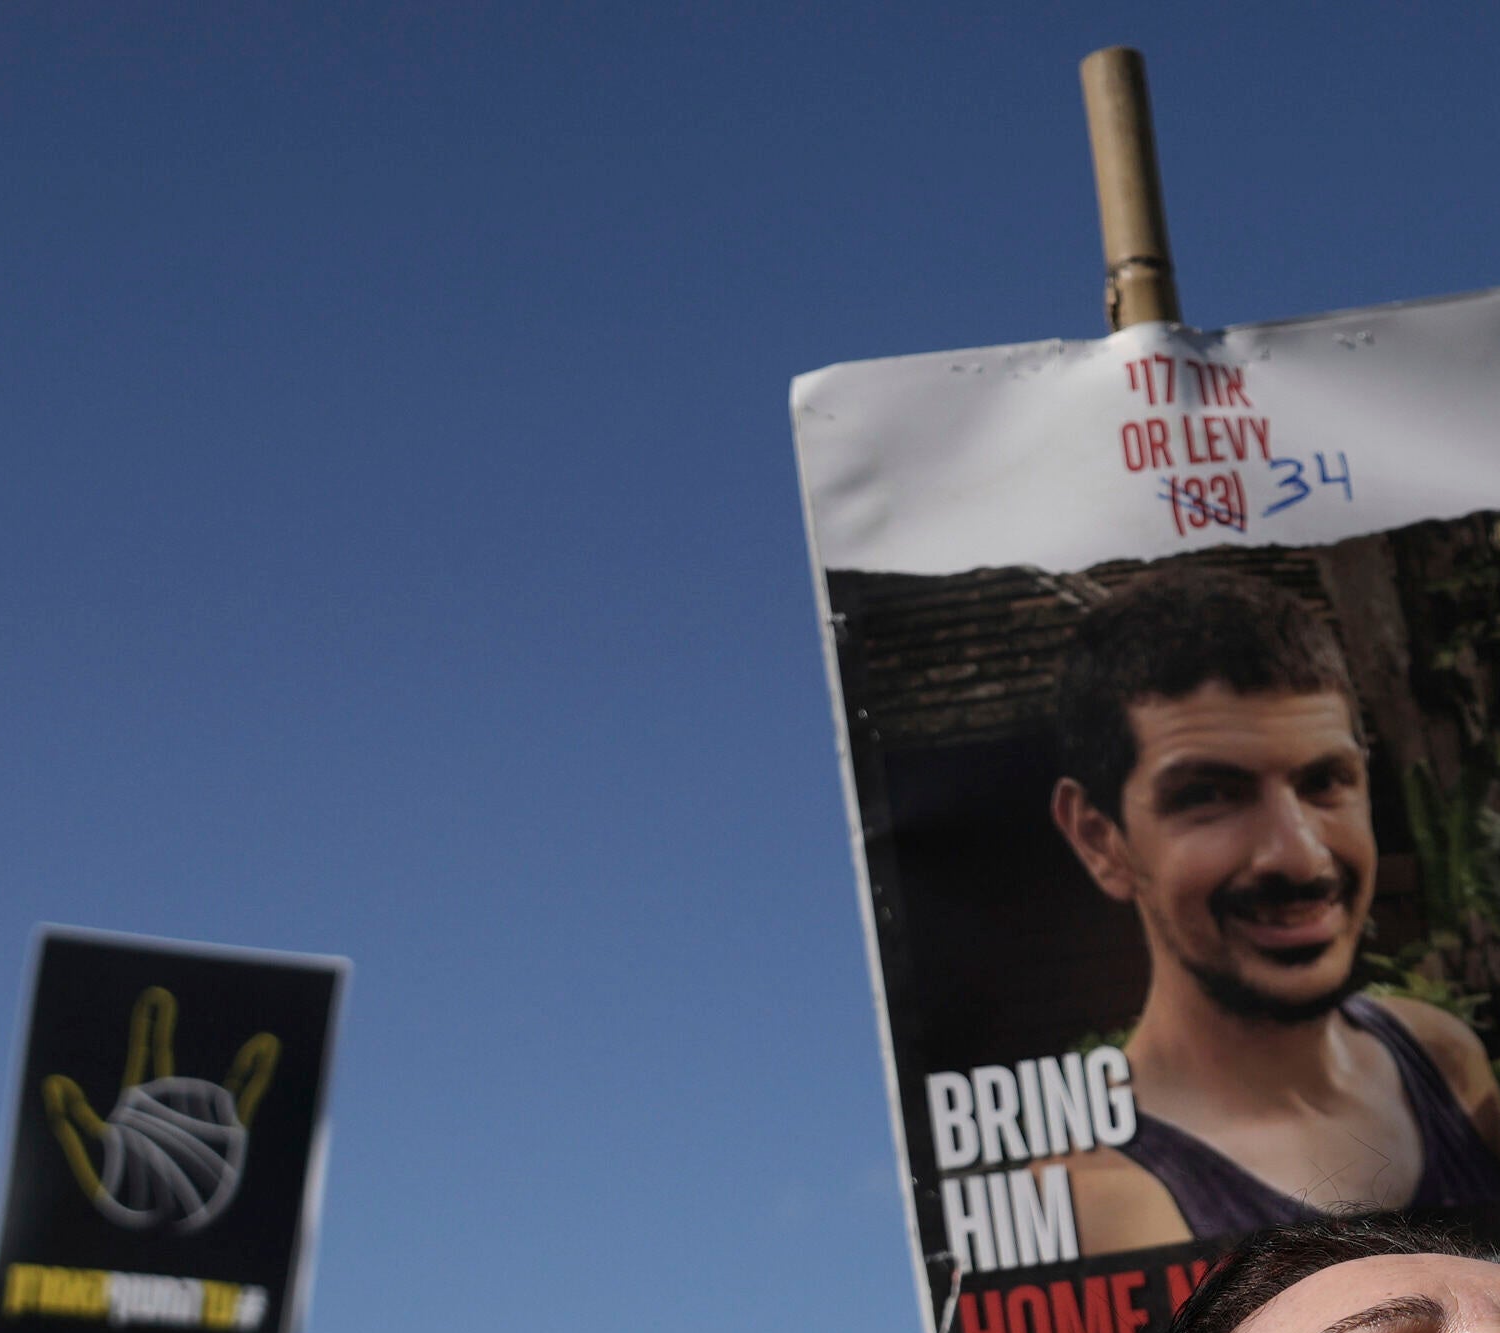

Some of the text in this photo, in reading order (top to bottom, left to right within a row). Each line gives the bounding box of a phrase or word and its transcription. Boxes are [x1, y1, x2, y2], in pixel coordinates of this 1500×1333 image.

[1125, 353, 1252, 408] אור לוי
[1121, 413, 1271, 473] OR LEVY
[1262, 452, 1352, 518] 34
[926, 1046, 1137, 1169] BRING
[941, 1164, 1079, 1274] HIM
